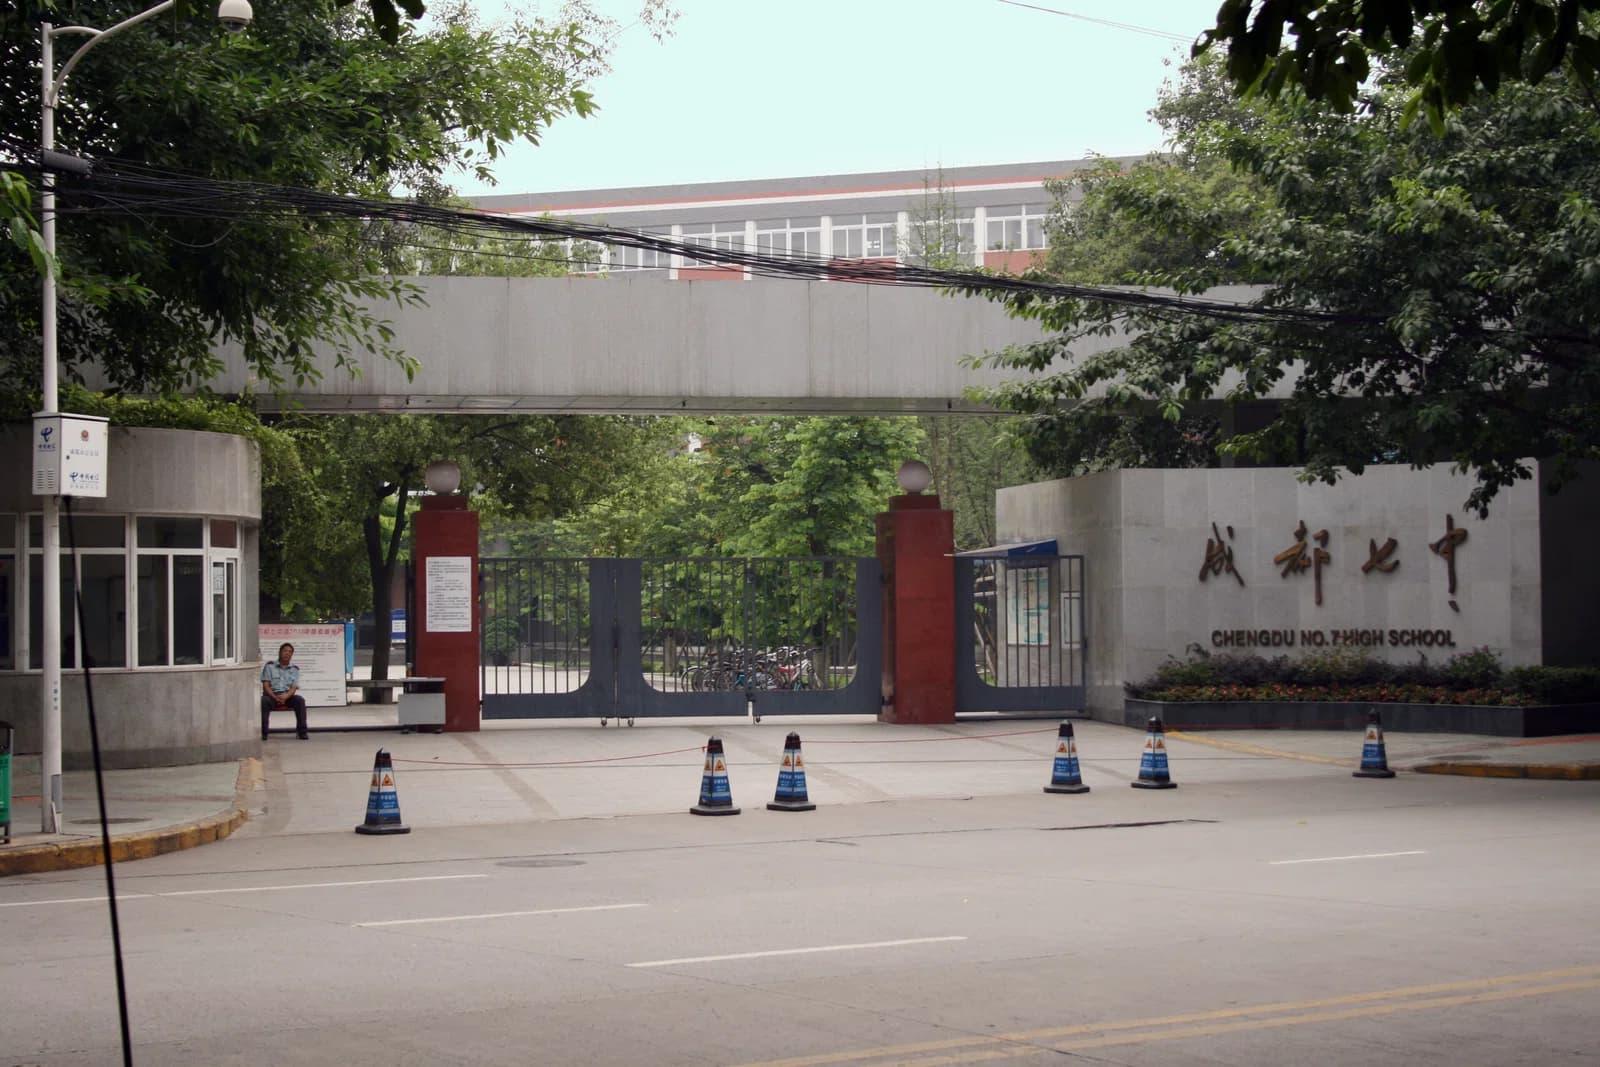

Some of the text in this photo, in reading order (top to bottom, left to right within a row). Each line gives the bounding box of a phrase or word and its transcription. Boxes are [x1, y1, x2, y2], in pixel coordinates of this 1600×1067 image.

[1199, 513, 1468, 613] 成都七中
[1211, 629, 1456, 648] CHENGDU NO.7 HIGH SCHOOL
